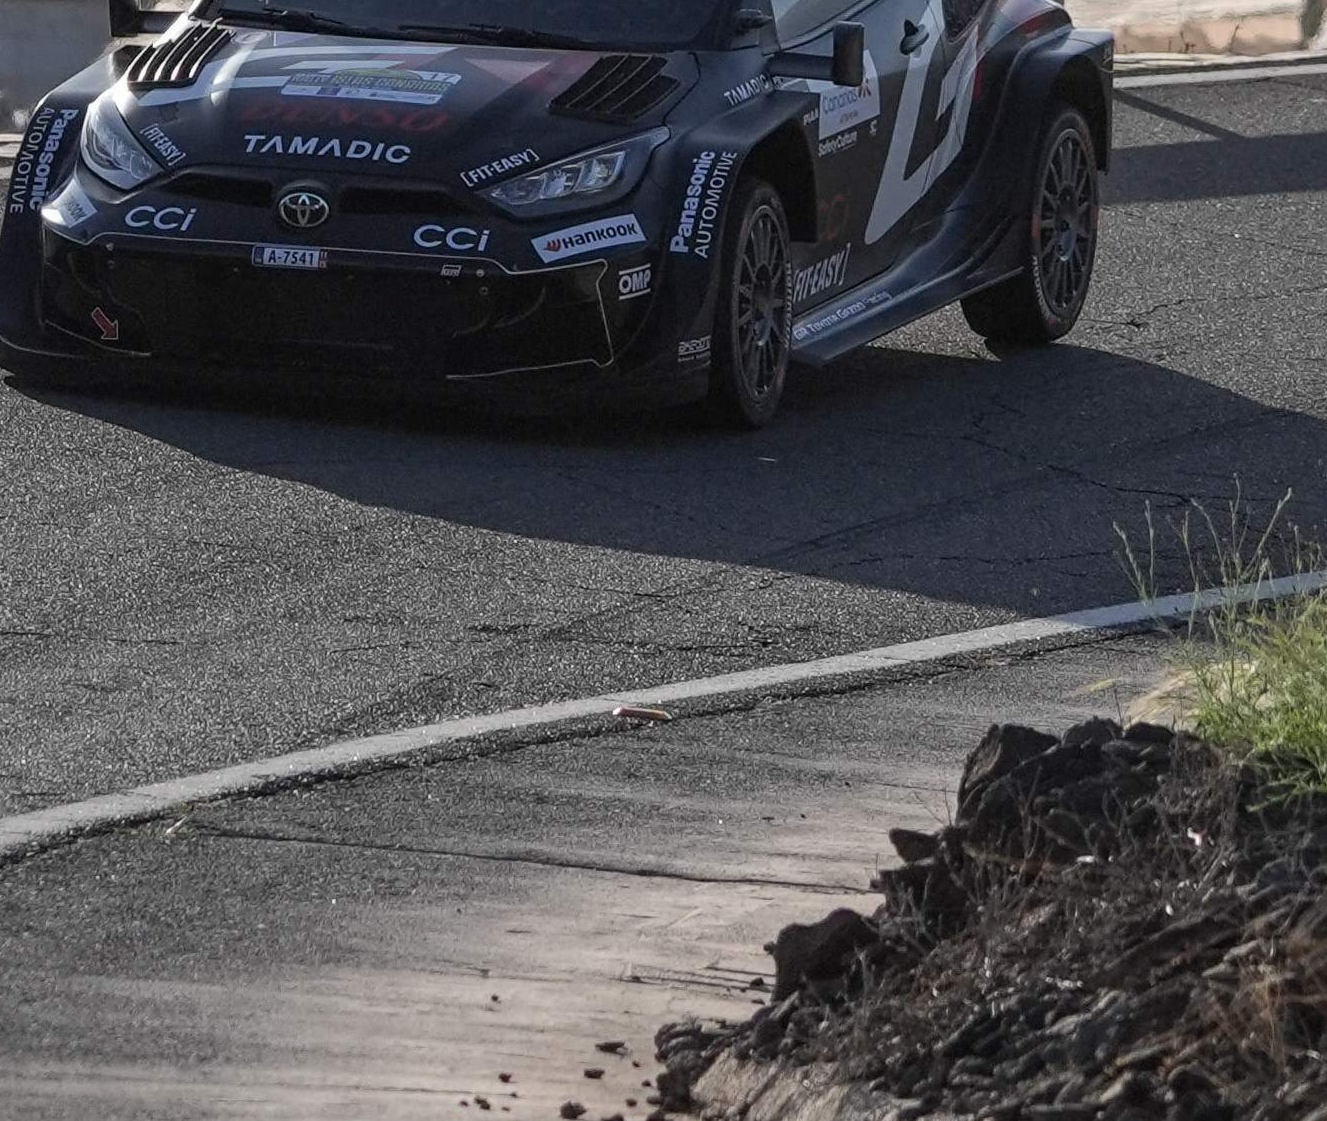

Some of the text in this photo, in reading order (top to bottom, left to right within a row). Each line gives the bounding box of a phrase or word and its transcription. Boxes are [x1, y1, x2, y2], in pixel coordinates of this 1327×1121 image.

[724, 74, 769, 106] TAMADIC
[10, 107, 56, 214] AUTOMOTIVE
[29, 108, 79, 211] Panasonic
[243, 135, 411, 164] TAMADIC
[669, 151, 716, 254] Panasonic
[694, 150, 738, 259] AUTOMOTIVE
[267, 250, 315, 266] A-7541
[618, 269, 652, 294] OMP
